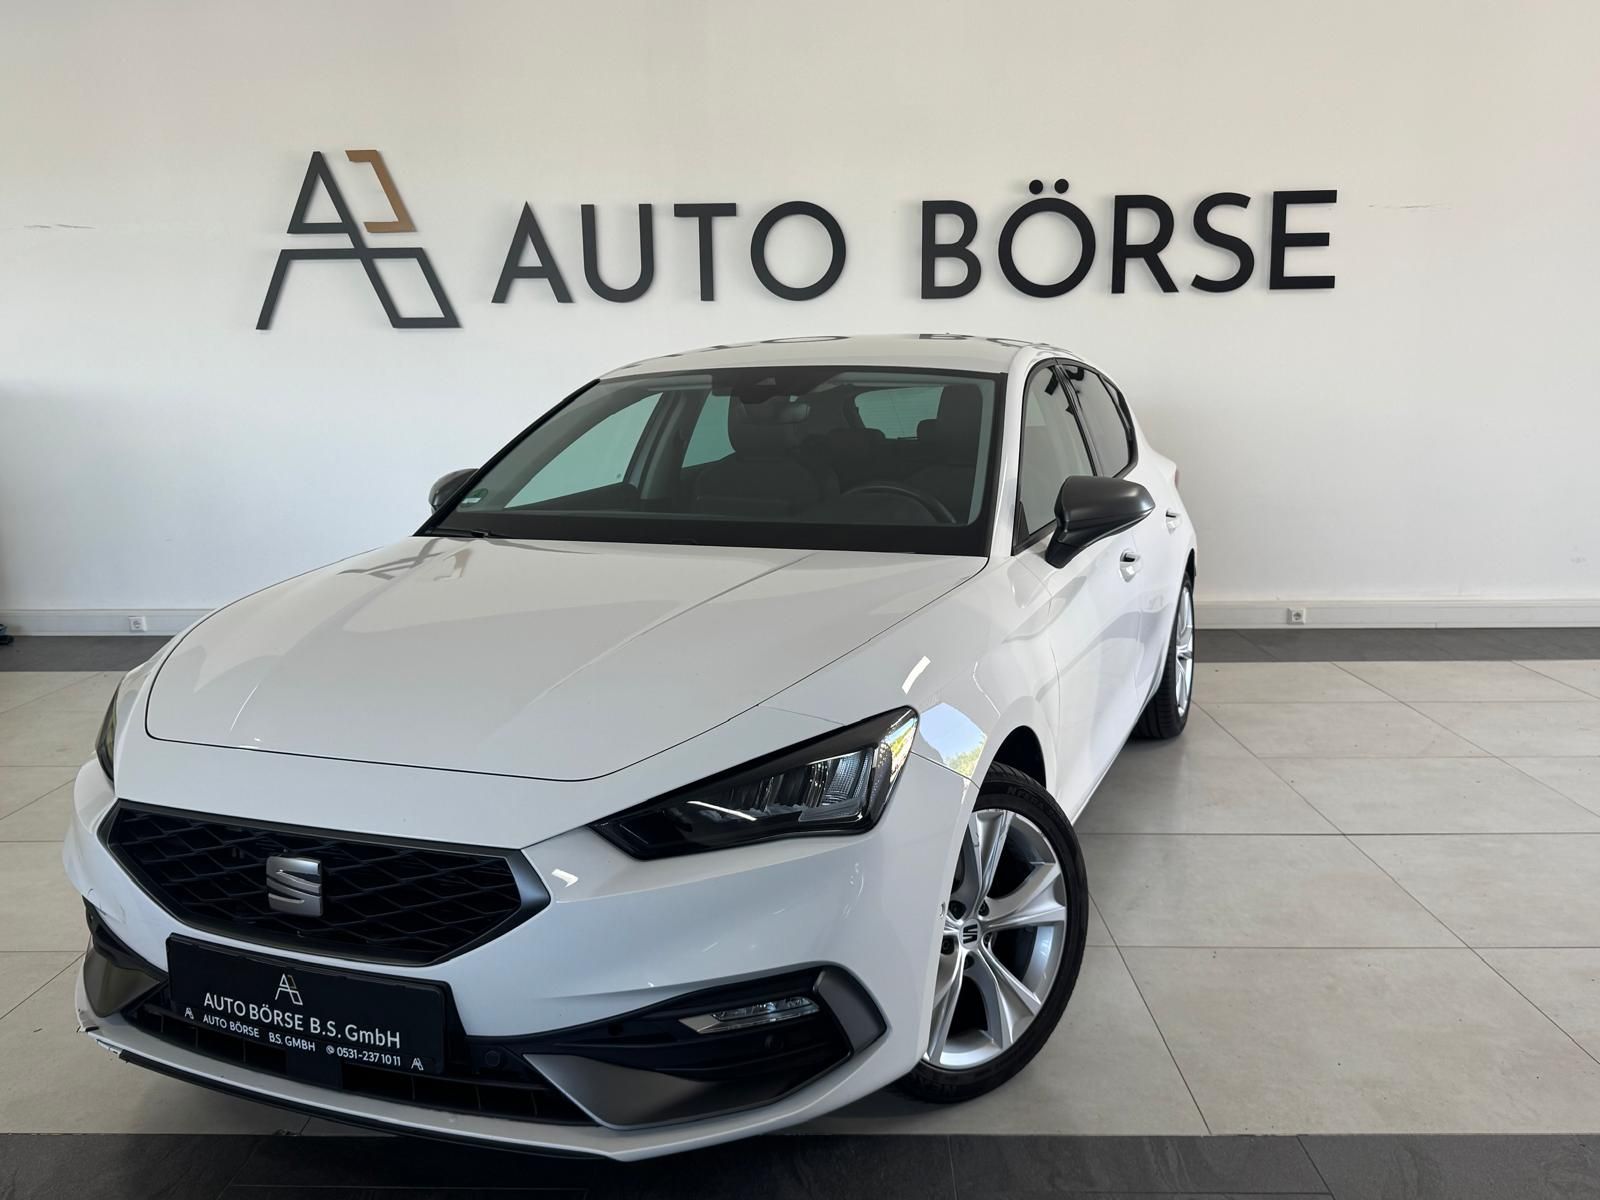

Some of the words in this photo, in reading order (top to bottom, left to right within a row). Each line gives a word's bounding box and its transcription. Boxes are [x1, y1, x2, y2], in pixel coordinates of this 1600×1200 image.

[491, 201, 847, 303] AUTO
[921, 179, 1338, 299] BÖRSE
[202, 1013, 227, 1029] AUTO
[229, 1021, 260, 1038] BÖRSE
[284, 1035, 316, 1052] GMBH
[203, 992, 246, 1017] AUTO
[249, 1003, 304, 1031] BÖRSE
[310, 1017, 342, 1039] B.S.
[345, 1024, 401, 1049] GmbH
